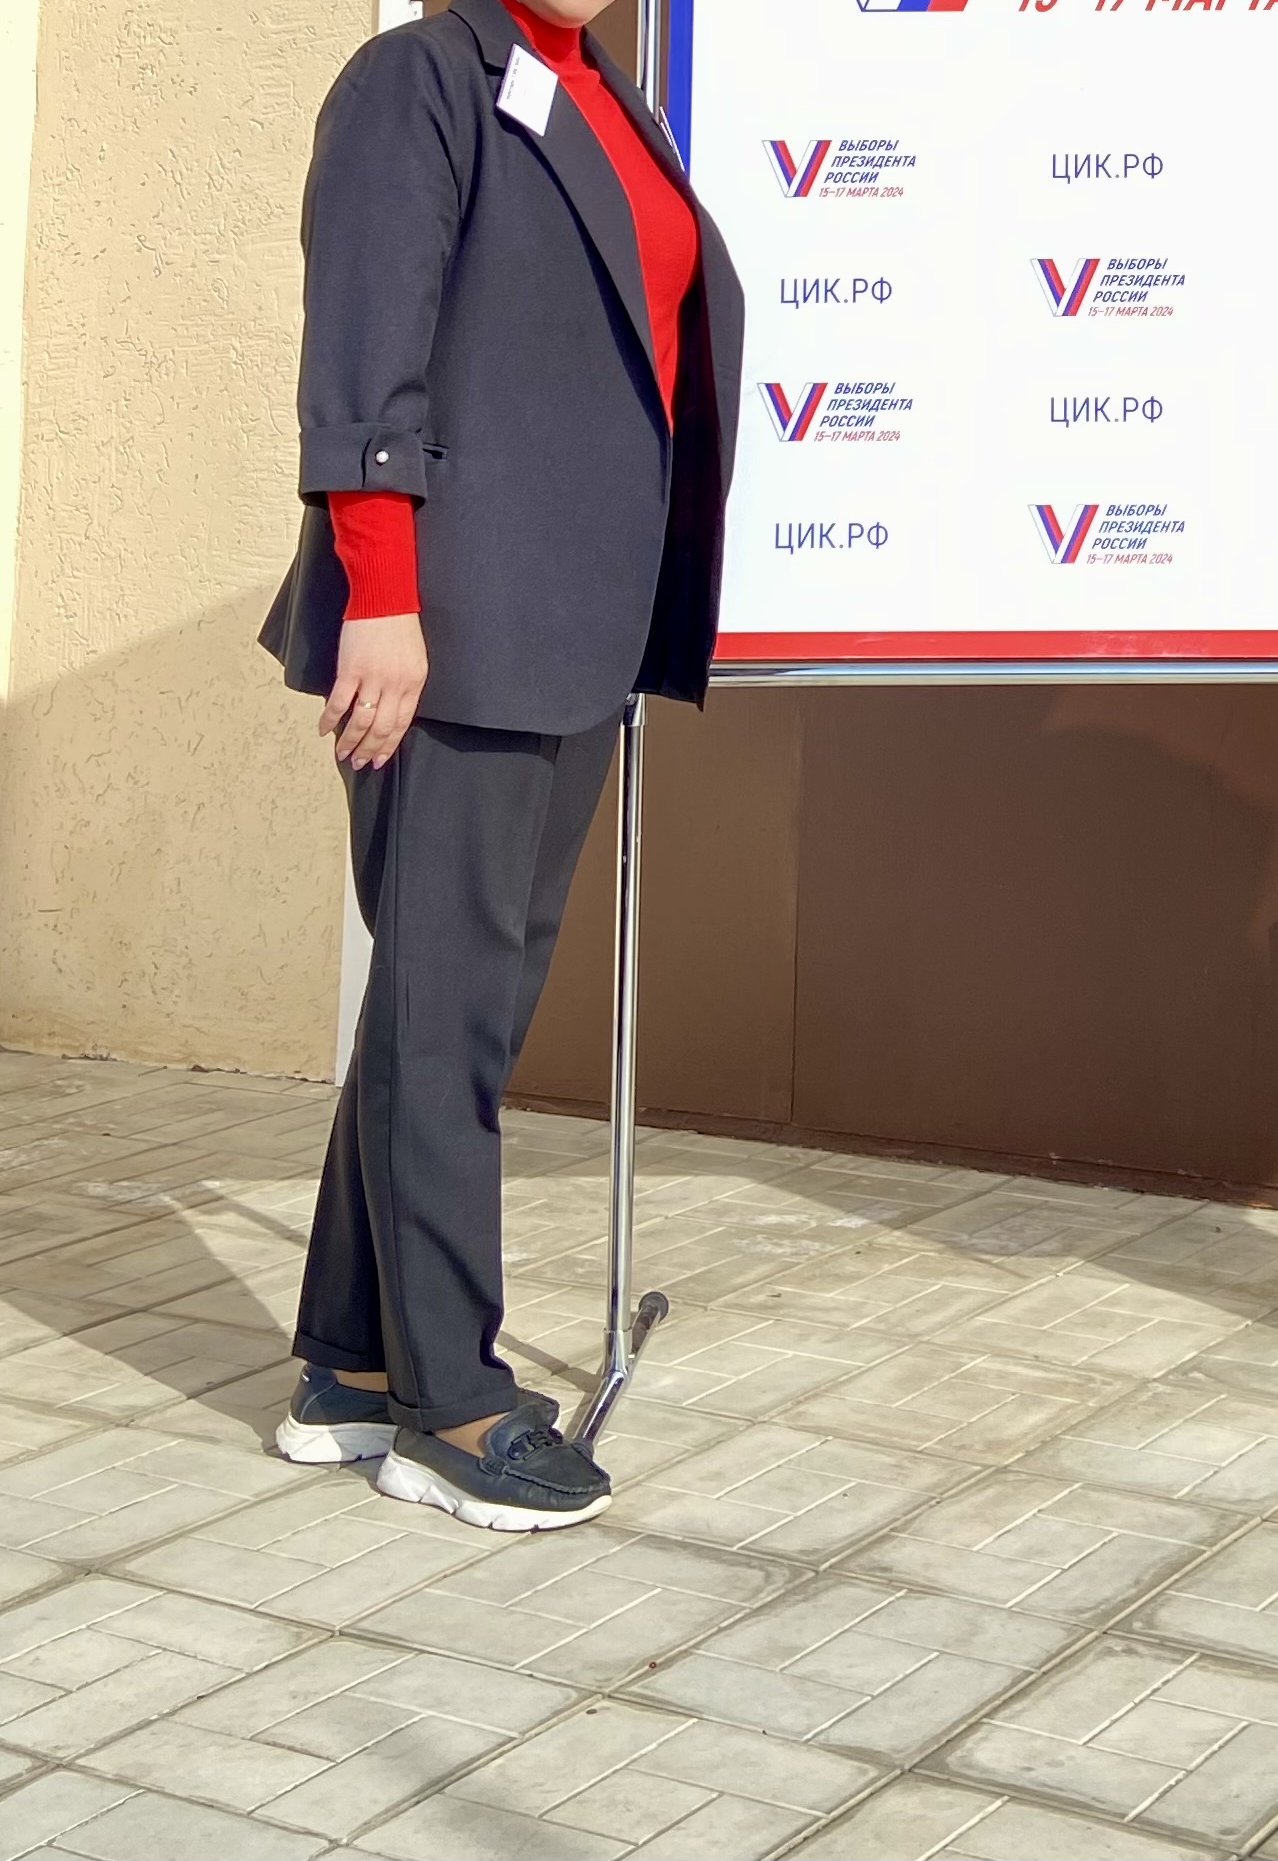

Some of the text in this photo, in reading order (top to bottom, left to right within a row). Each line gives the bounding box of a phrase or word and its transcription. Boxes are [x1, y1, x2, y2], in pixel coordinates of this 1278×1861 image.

[838, 139, 899, 151] ВЫБОРЫ
[831, 155, 916, 168] ПРЕЗИДЕНТА
[1053, 153, 1163, 184] ЦИК.РФ
[824, 172, 878, 184] РОССИИ
[848, 187, 880, 197] МАРТА
[881, 187, 904, 197] 2024
[1107, 258, 1168, 270] ВЫБОРЫ
[1100, 274, 1185, 287] ПРЕЗИДЕНТА
[780, 277, 892, 309] ЦИК.РФ
[1093, 291, 1148, 302] РОССИИ
[1116, 306, 1149, 316] МАРТА
[1150, 306, 1173, 316] 2024
[834, 382, 896, 394] ВЫБОРЫ
[827, 398, 913, 411] ПРЕЗИДЕНТА
[1051, 396, 1163, 427] ЦИК.РФ
[820, 415, 875, 427] РОССИИ
[843, 431, 876, 441] МАРТА
[877, 430, 901, 441] 2024
[1105, 504, 1167, 516] ВЫБОРЫ
[1099, 520, 1184, 533] ПРЕЗИДЕНТА
[775, 522, 888, 554] ЦИК.РФ
[1092, 537, 1146, 549] РОССИИ
[1115, 553, 1148, 564] МАРТА
[1149, 553, 1173, 564] 2024
